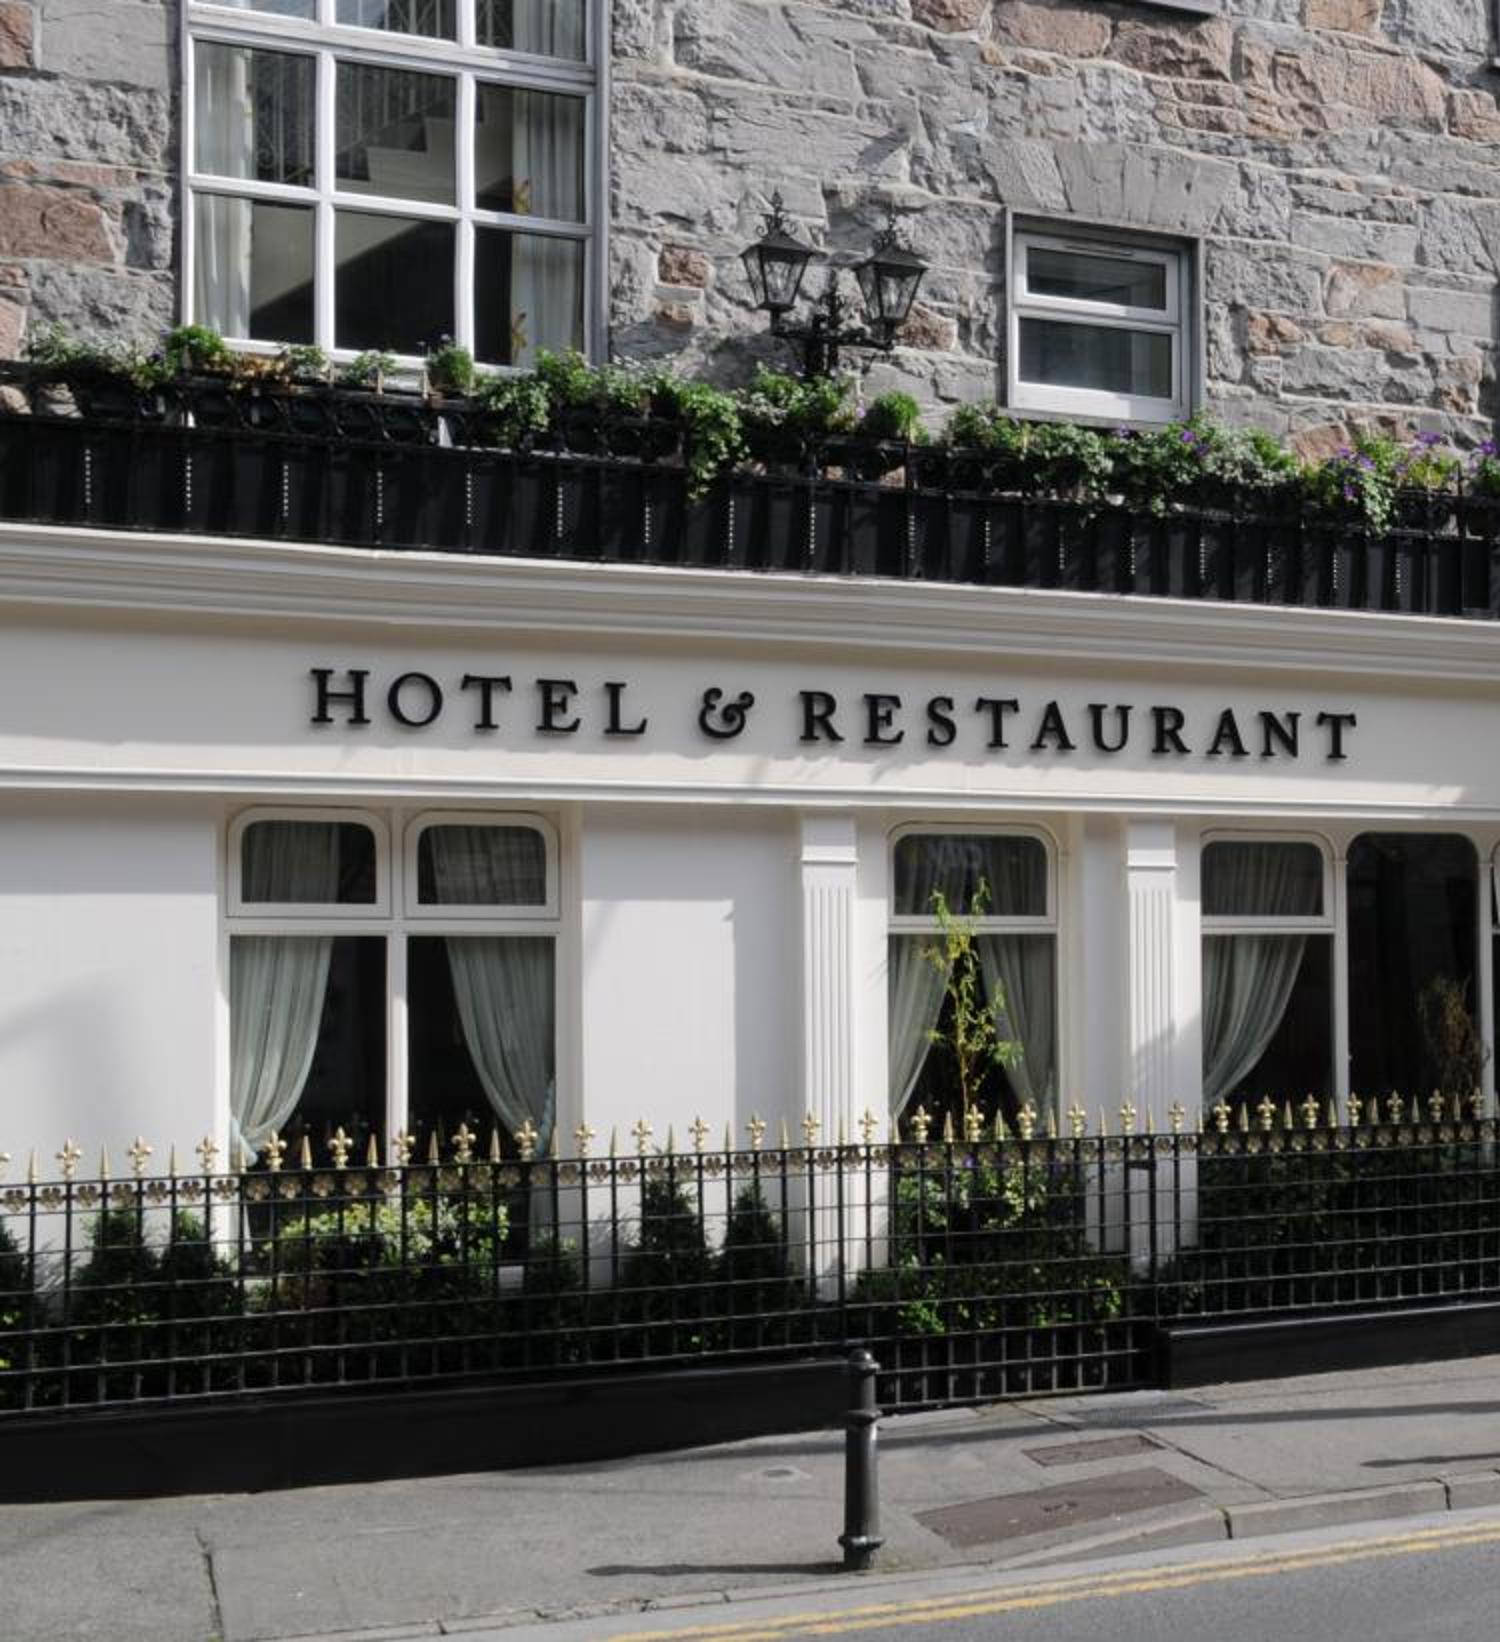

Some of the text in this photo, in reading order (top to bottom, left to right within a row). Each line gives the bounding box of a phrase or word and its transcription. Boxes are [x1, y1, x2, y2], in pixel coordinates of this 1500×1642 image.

[309, 668, 1357, 760] HOTEL & RESTAURANT
